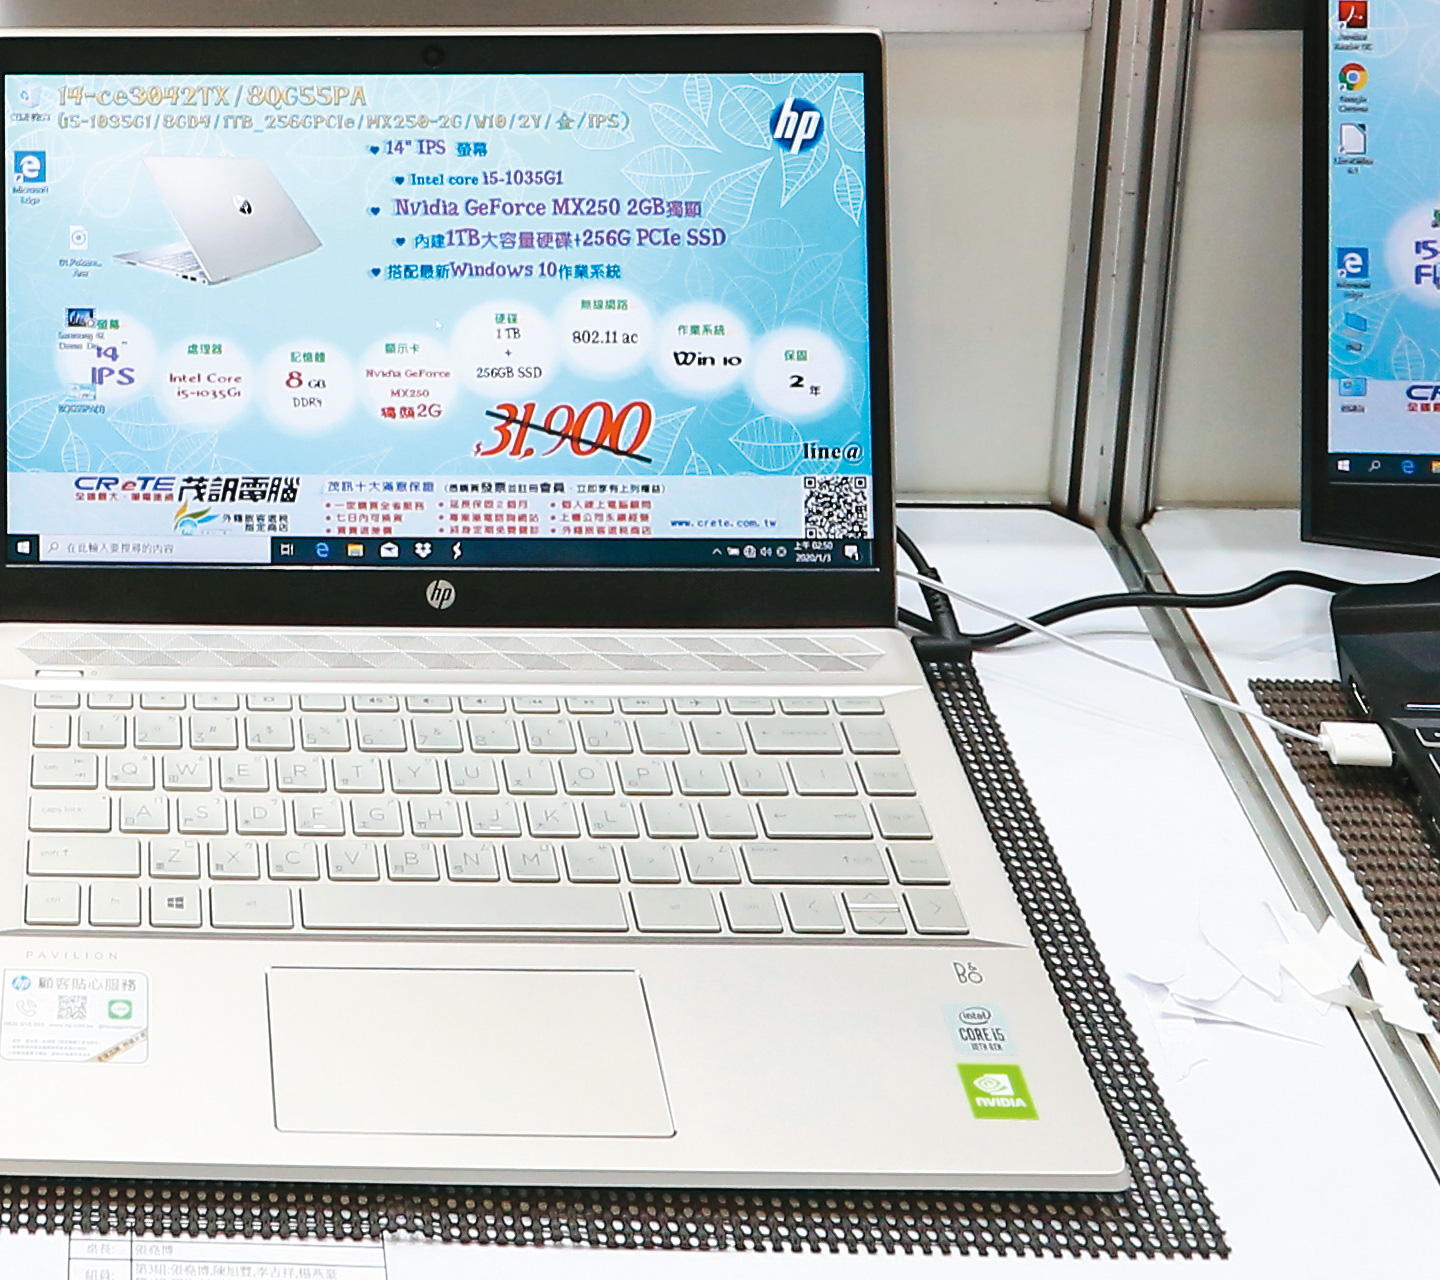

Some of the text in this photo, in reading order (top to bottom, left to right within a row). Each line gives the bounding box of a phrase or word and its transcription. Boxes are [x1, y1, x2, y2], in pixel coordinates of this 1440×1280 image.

[773, 96, 821, 154] hp
[417, 139, 447, 156] IPS
[410, 172, 445, 186] Intel
[448, 173, 479, 186] core
[394, 198, 460, 217] Nvidia
[464, 197, 547, 217] GeForce
[551, 197, 621, 216] MX250
[635, 227, 728, 248] PCIe SSD
[571, 330, 639, 345] 802.11 ac
[673, 350, 743, 367] Win 10
[90, 366, 136, 387] IPS
[169, 372, 242, 385] Intel Core
[284, 370, 303, 389] 8
[516, 366, 543, 380] SSD
[177, 475, 302, 504] 茂訊電腦
[425, 578, 457, 610] hp
[25, 950, 119, 961] PAVILION
[958, 1027, 990, 1042] CORE
